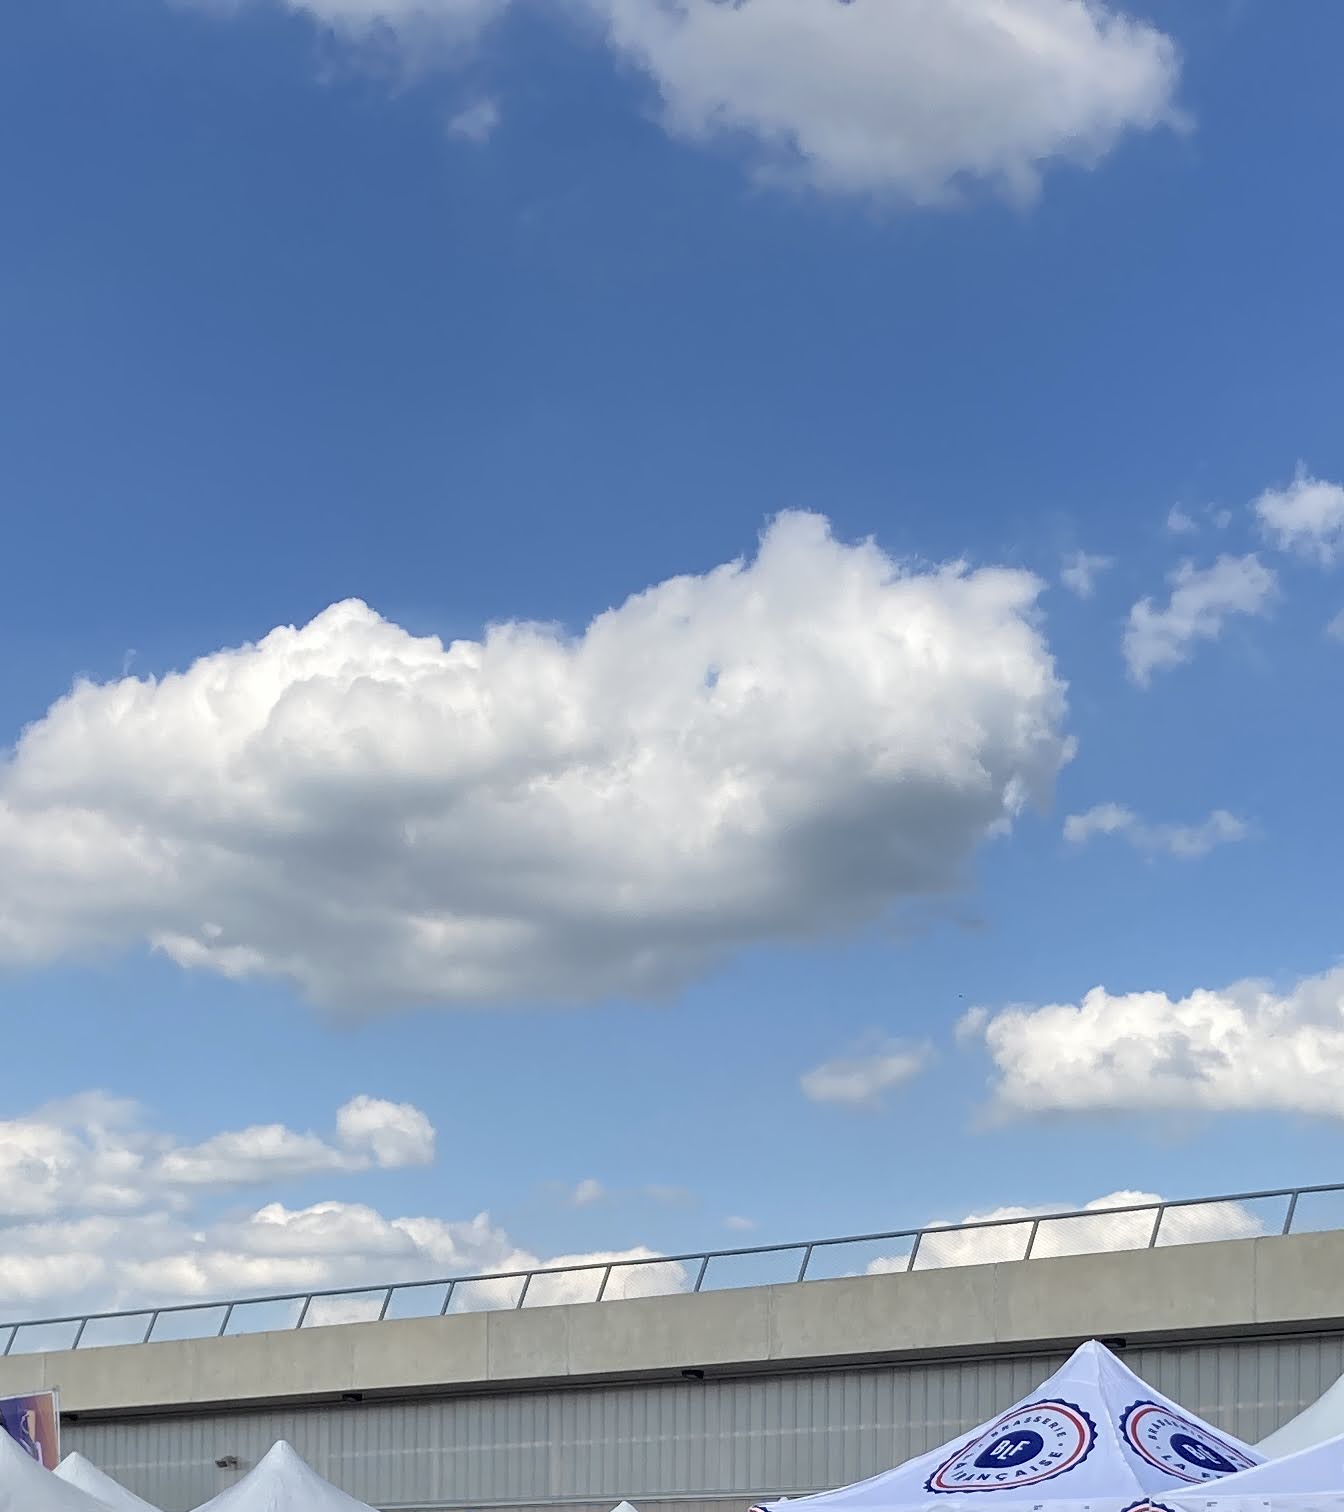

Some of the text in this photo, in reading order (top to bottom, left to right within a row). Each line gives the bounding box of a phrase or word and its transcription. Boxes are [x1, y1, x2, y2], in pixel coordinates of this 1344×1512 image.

[991, 1415, 1067, 1438] BRASSERIE
[989, 1439, 1031, 1460] BLF
[951, 1451, 1064, 1482] FRANÇAISE
